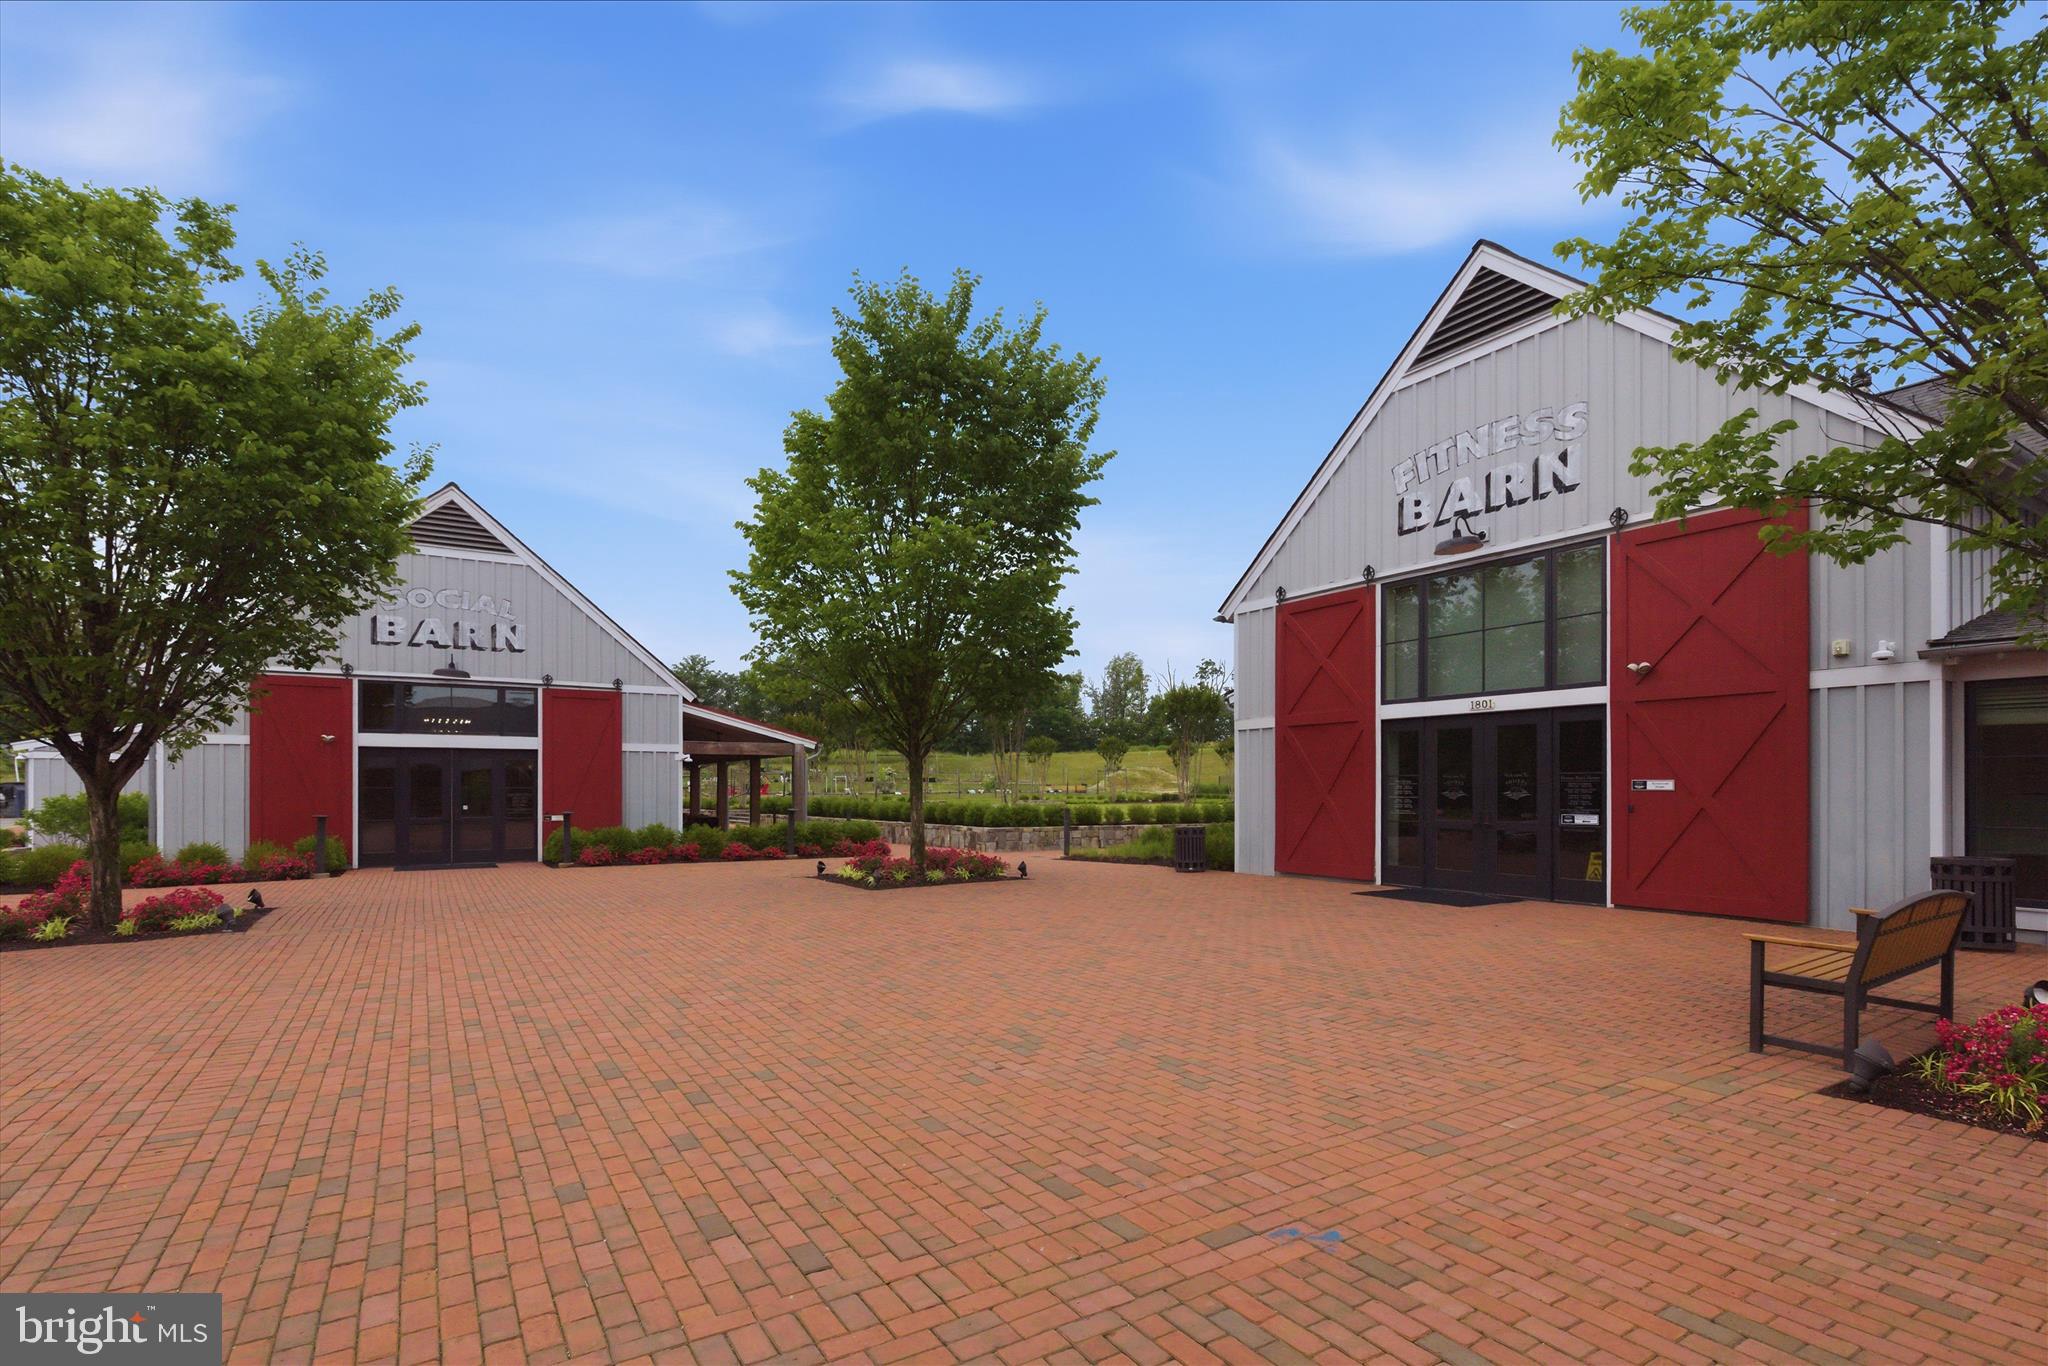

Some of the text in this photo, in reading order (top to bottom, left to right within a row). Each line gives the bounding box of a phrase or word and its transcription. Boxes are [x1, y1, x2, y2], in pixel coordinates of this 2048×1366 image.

[1391, 401, 1589, 495] FITNESS
[1398, 443, 1581, 536] BARN
[379, 587, 517, 621] SOCIAL
[371, 614, 527, 653] BARN
[1470, 699, 1493, 710] 1801
